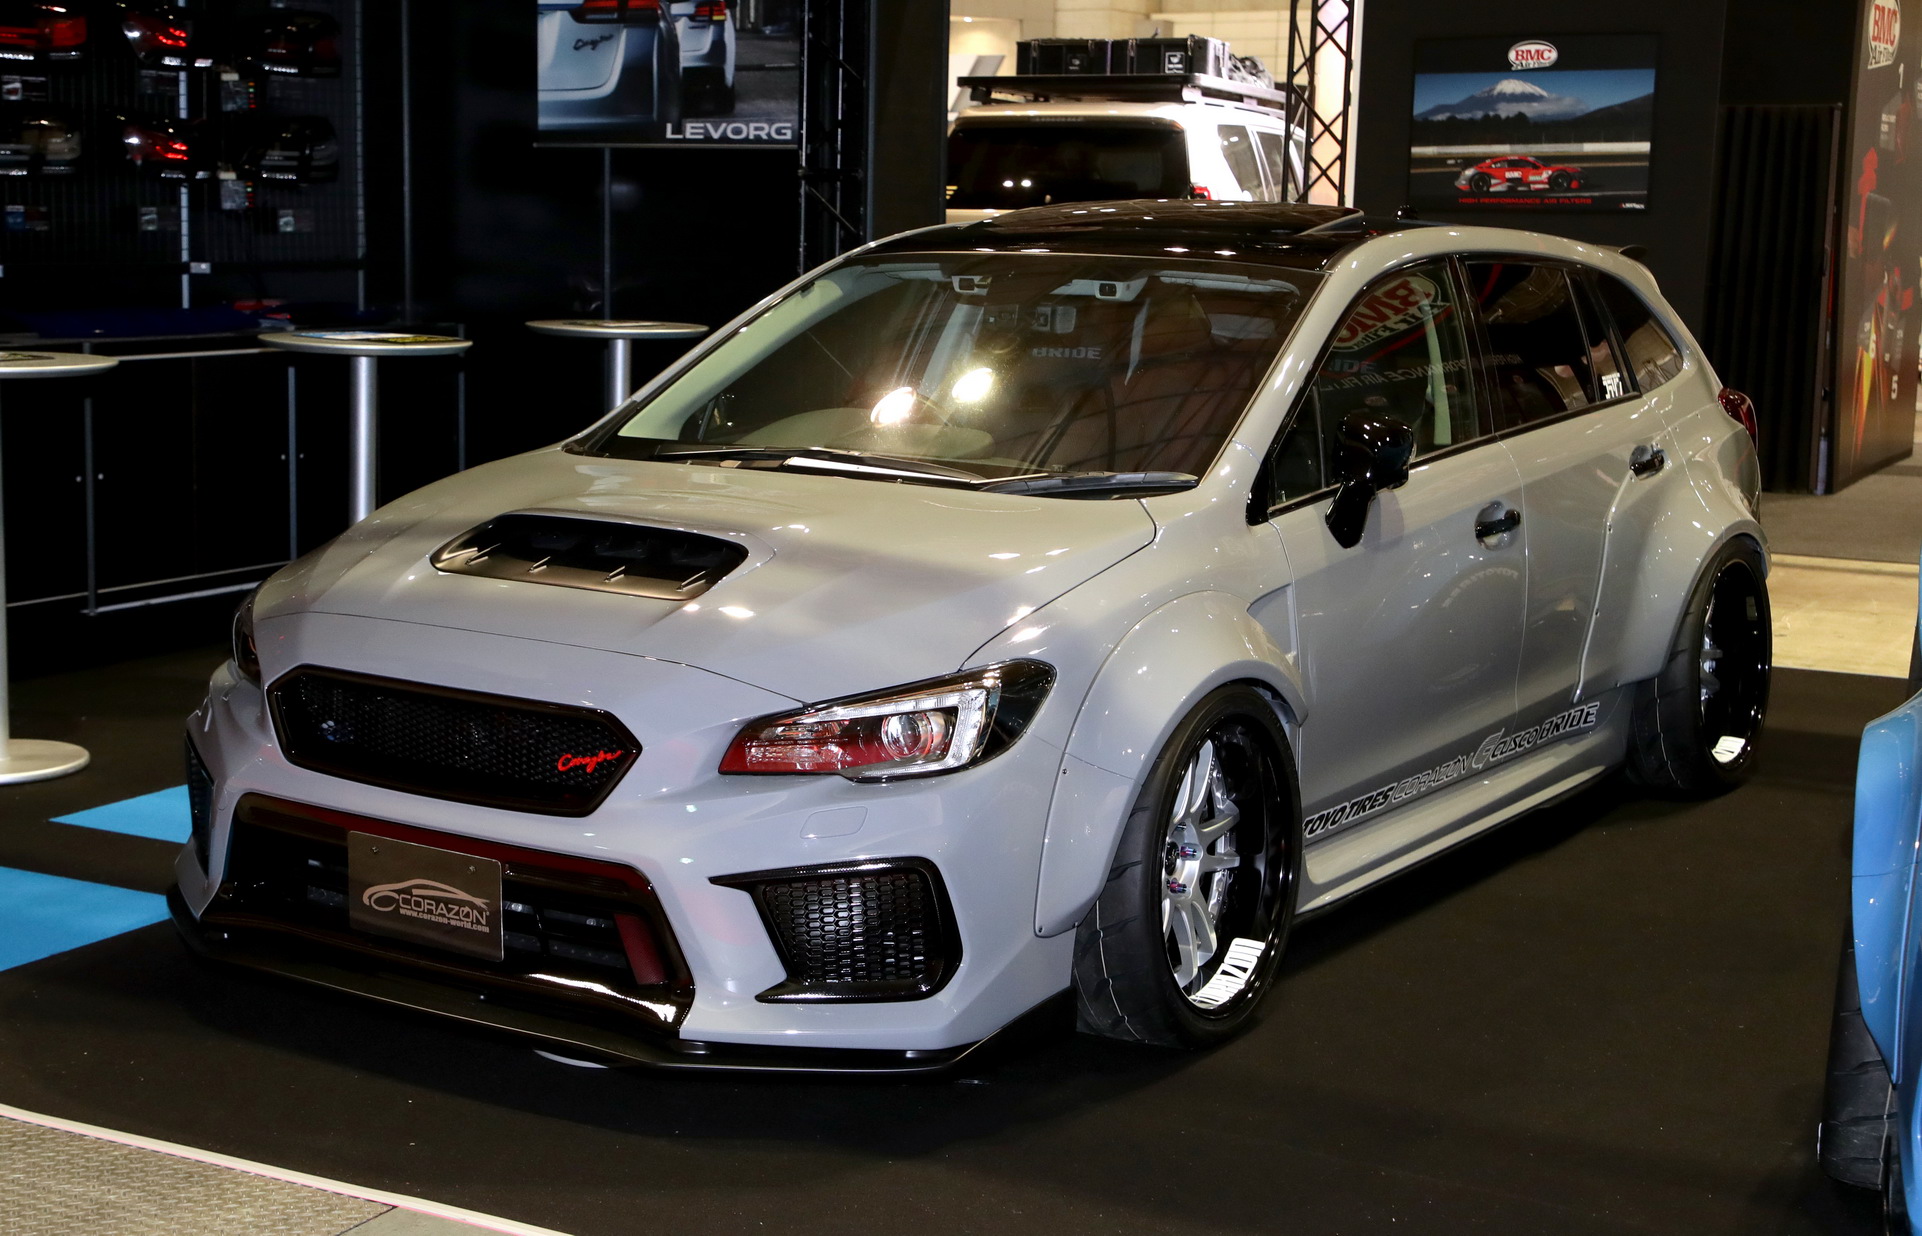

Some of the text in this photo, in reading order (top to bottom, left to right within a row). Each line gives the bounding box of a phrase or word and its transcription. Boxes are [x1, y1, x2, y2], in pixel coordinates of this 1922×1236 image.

[1872, 4, 1898, 47] BMC
[1514, 48, 1553, 62] BMC
[666, 122, 793, 140] LEVORG
[1302, 802, 1349, 838] TOYO
[1342, 782, 1398, 824] TIRES
[1490, 726, 1540, 761] CUSCO
[1538, 702, 1599, 743] BRIDE
[399, 908, 490, 934] www.corazon-world.com
